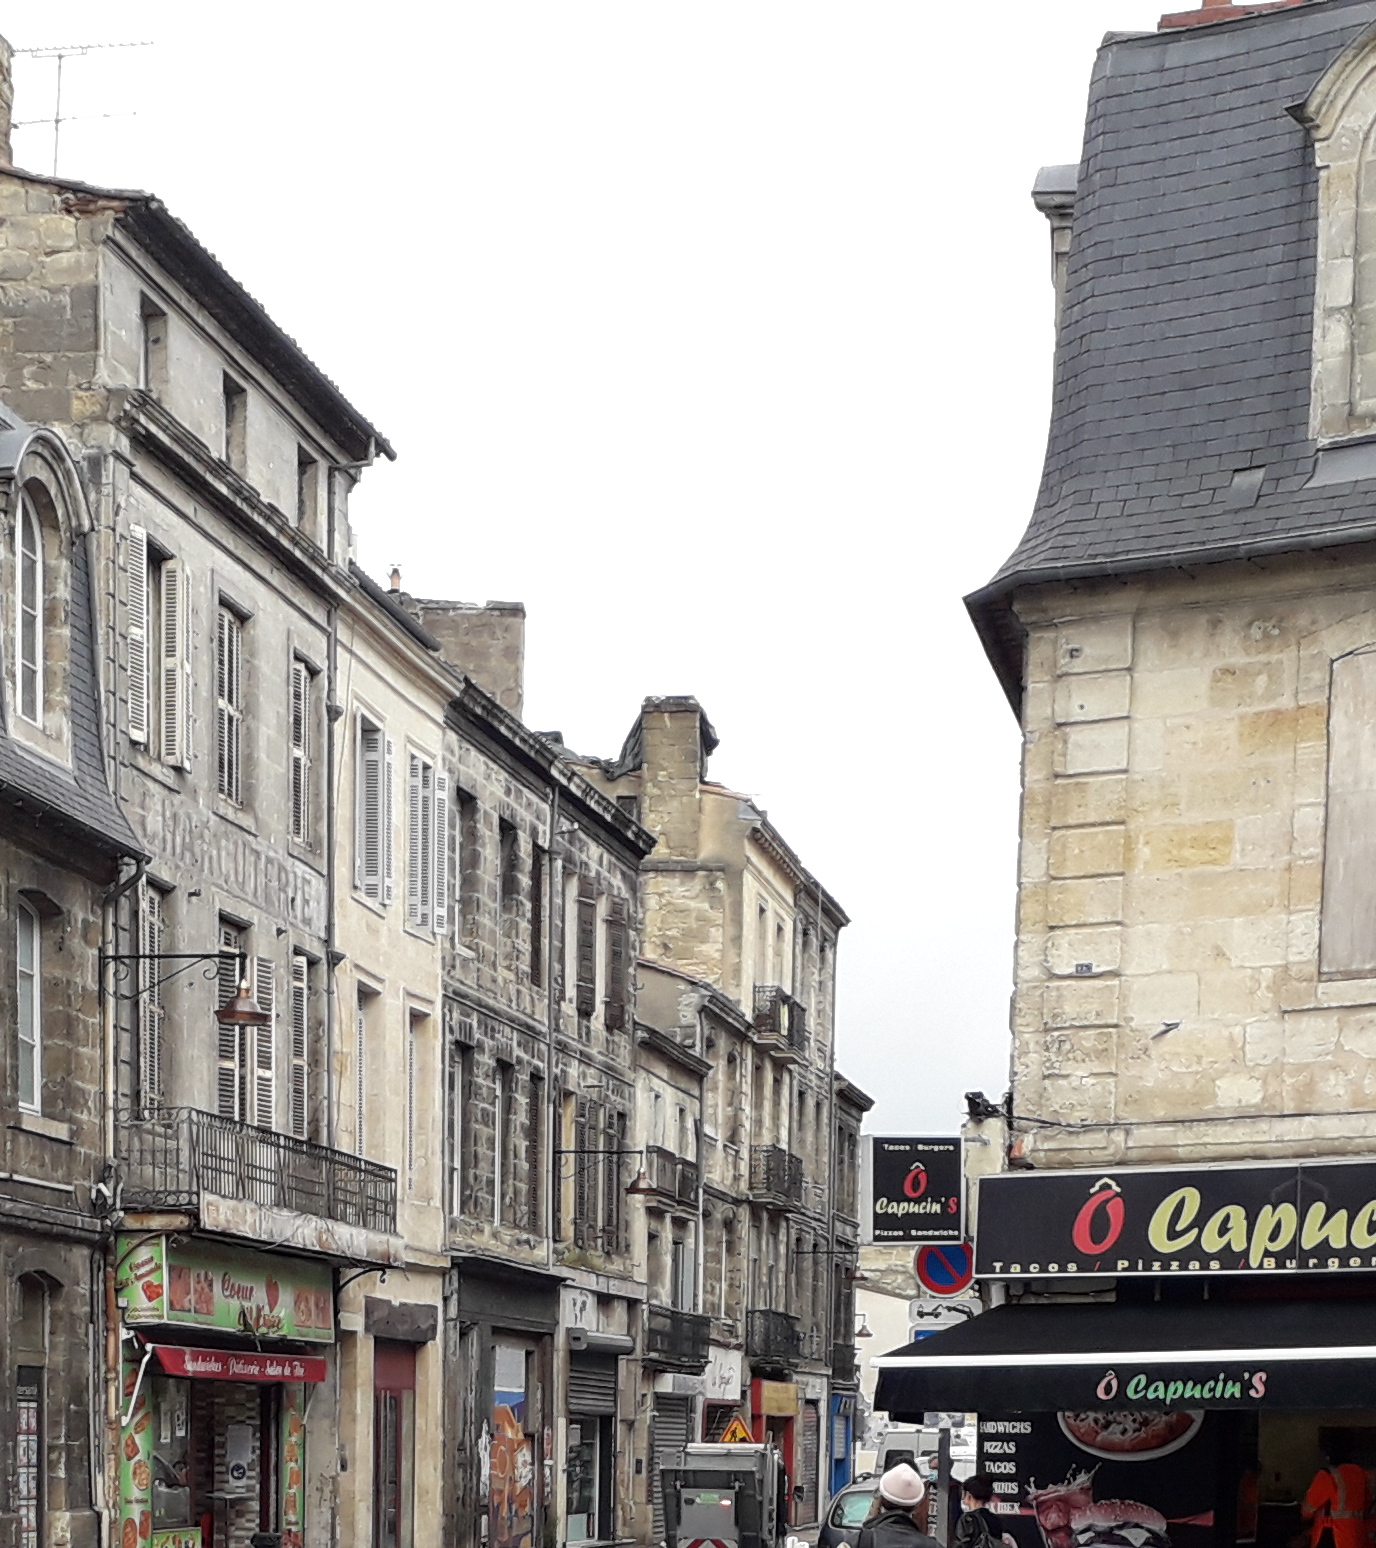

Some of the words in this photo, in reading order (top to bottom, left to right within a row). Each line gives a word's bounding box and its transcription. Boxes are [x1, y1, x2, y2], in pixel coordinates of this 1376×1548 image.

[903, 1162, 928, 1198] Ô
[875, 1196, 958, 1218] Capucin'S
[1072, 1177, 1126, 1255] Ô
[993, 1261, 1078, 1273] Tacos
[1117, 1258, 1220, 1271] Pizzas
[1096, 1370, 1118, 1400] Ô
[1126, 1371, 1267, 1405] Capucin'S
[984, 1461, 1016, 1474] TACOS
